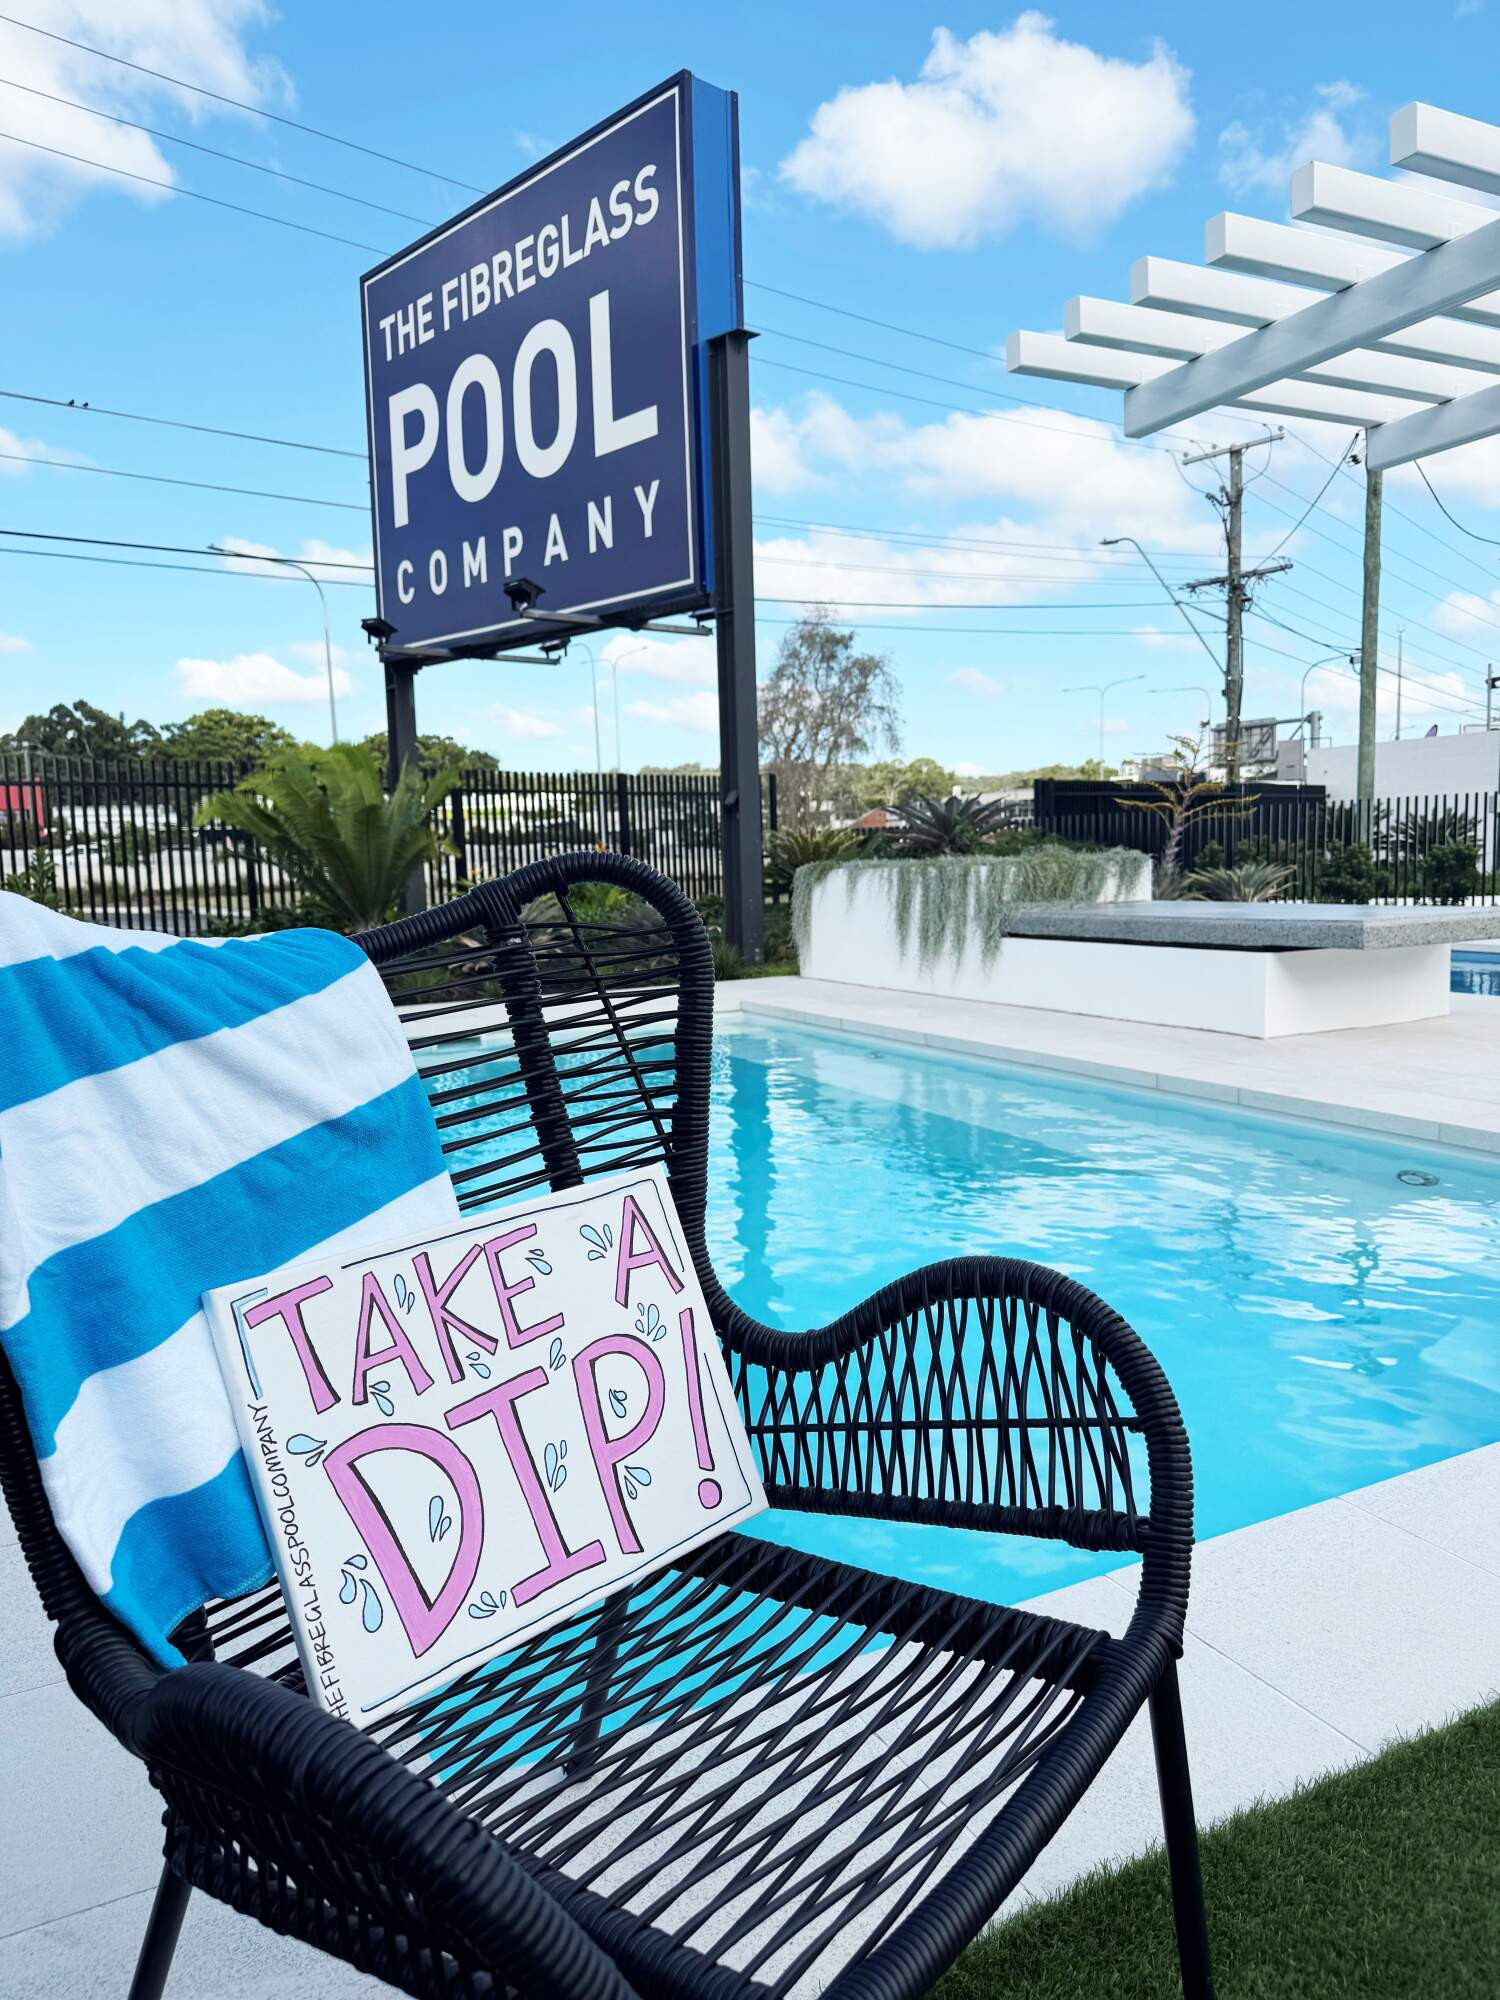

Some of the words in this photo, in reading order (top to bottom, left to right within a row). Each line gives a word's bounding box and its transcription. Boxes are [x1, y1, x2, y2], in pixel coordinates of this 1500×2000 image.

[379, 291, 434, 362] THE
[442, 164, 660, 332] FIBREGLASS
[388, 290, 659, 528] POOL
[397, 480, 660, 604] COMPANY
[243, 1223, 566, 1415] TAKE
[615, 1194, 685, 1309] A
[247, 1403, 351, 1722] HEFIBREGLASSPOOLCOMPANY
[322, 1307, 723, 1659] DIP!
